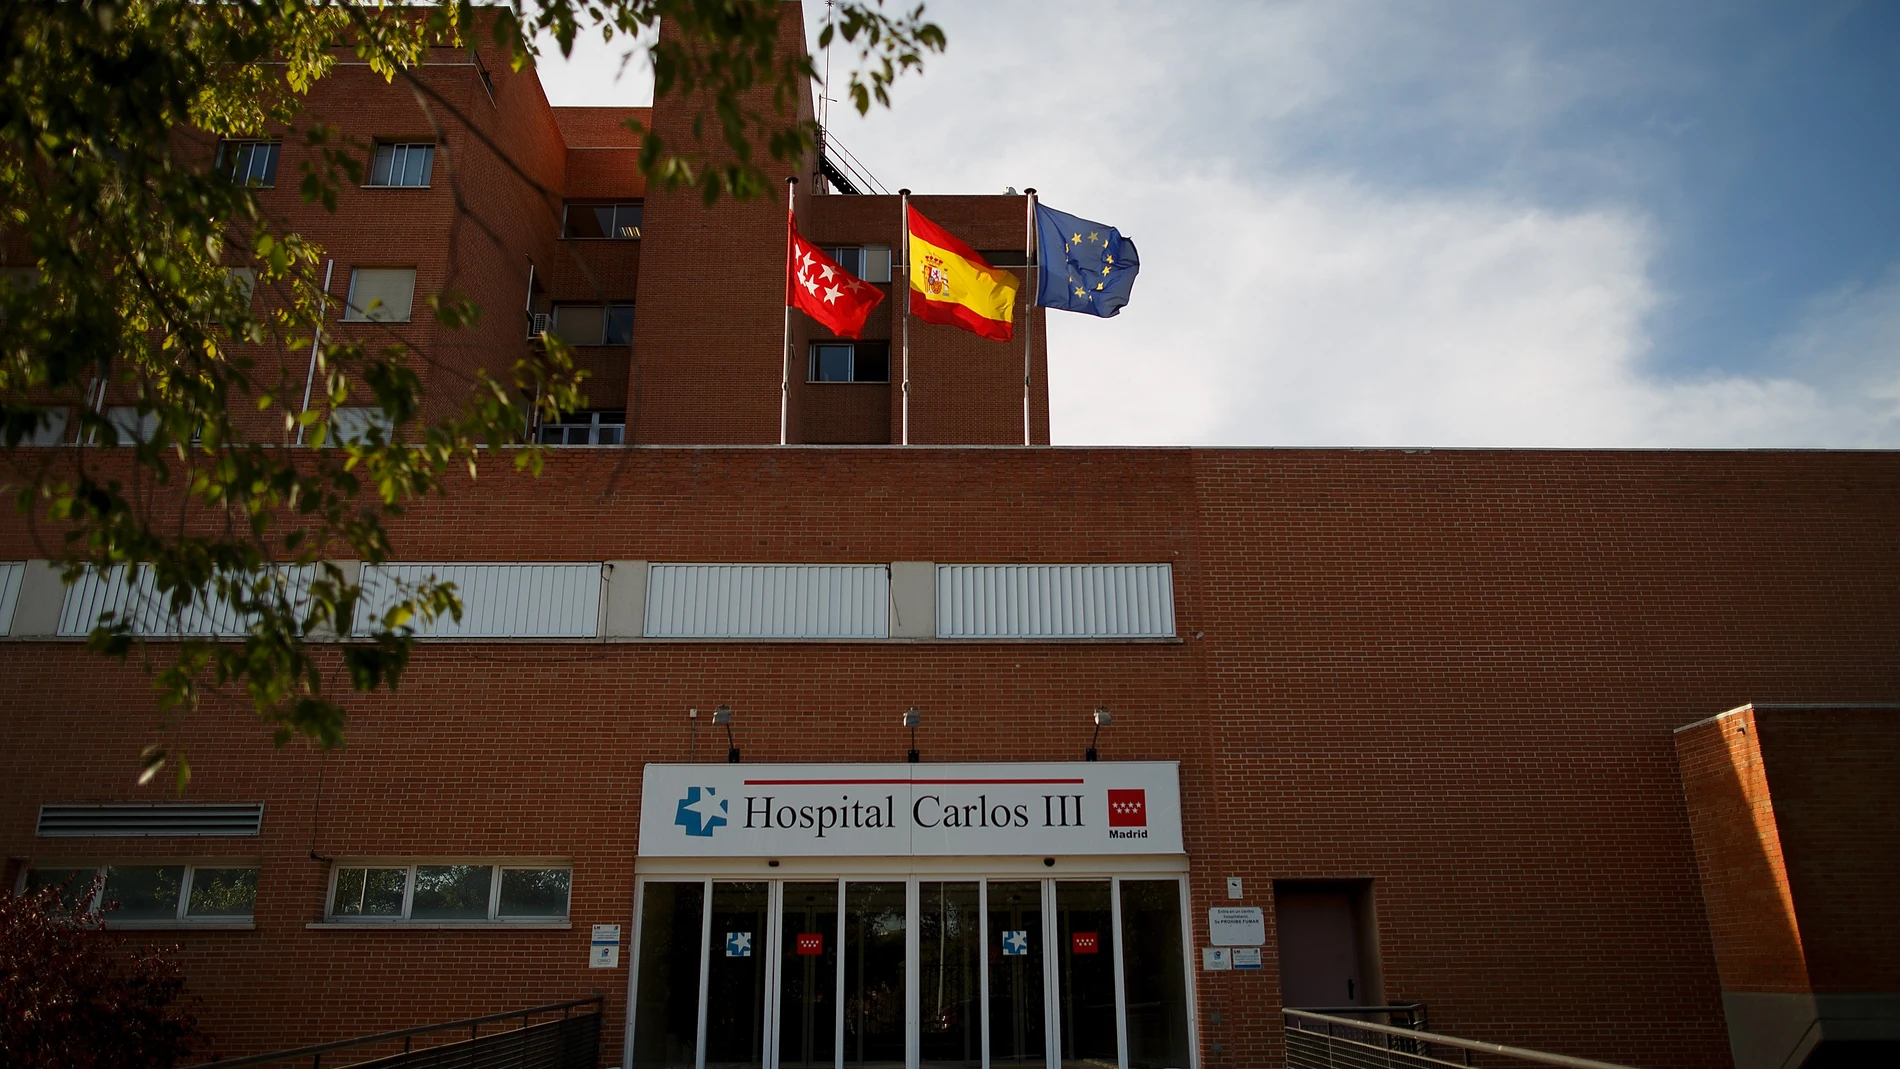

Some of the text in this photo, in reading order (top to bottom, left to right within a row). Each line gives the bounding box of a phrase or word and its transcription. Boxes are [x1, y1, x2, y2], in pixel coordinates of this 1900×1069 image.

[742, 795, 1086, 839] Hospital Carlos III
[1108, 829, 1149, 839] Madrid
